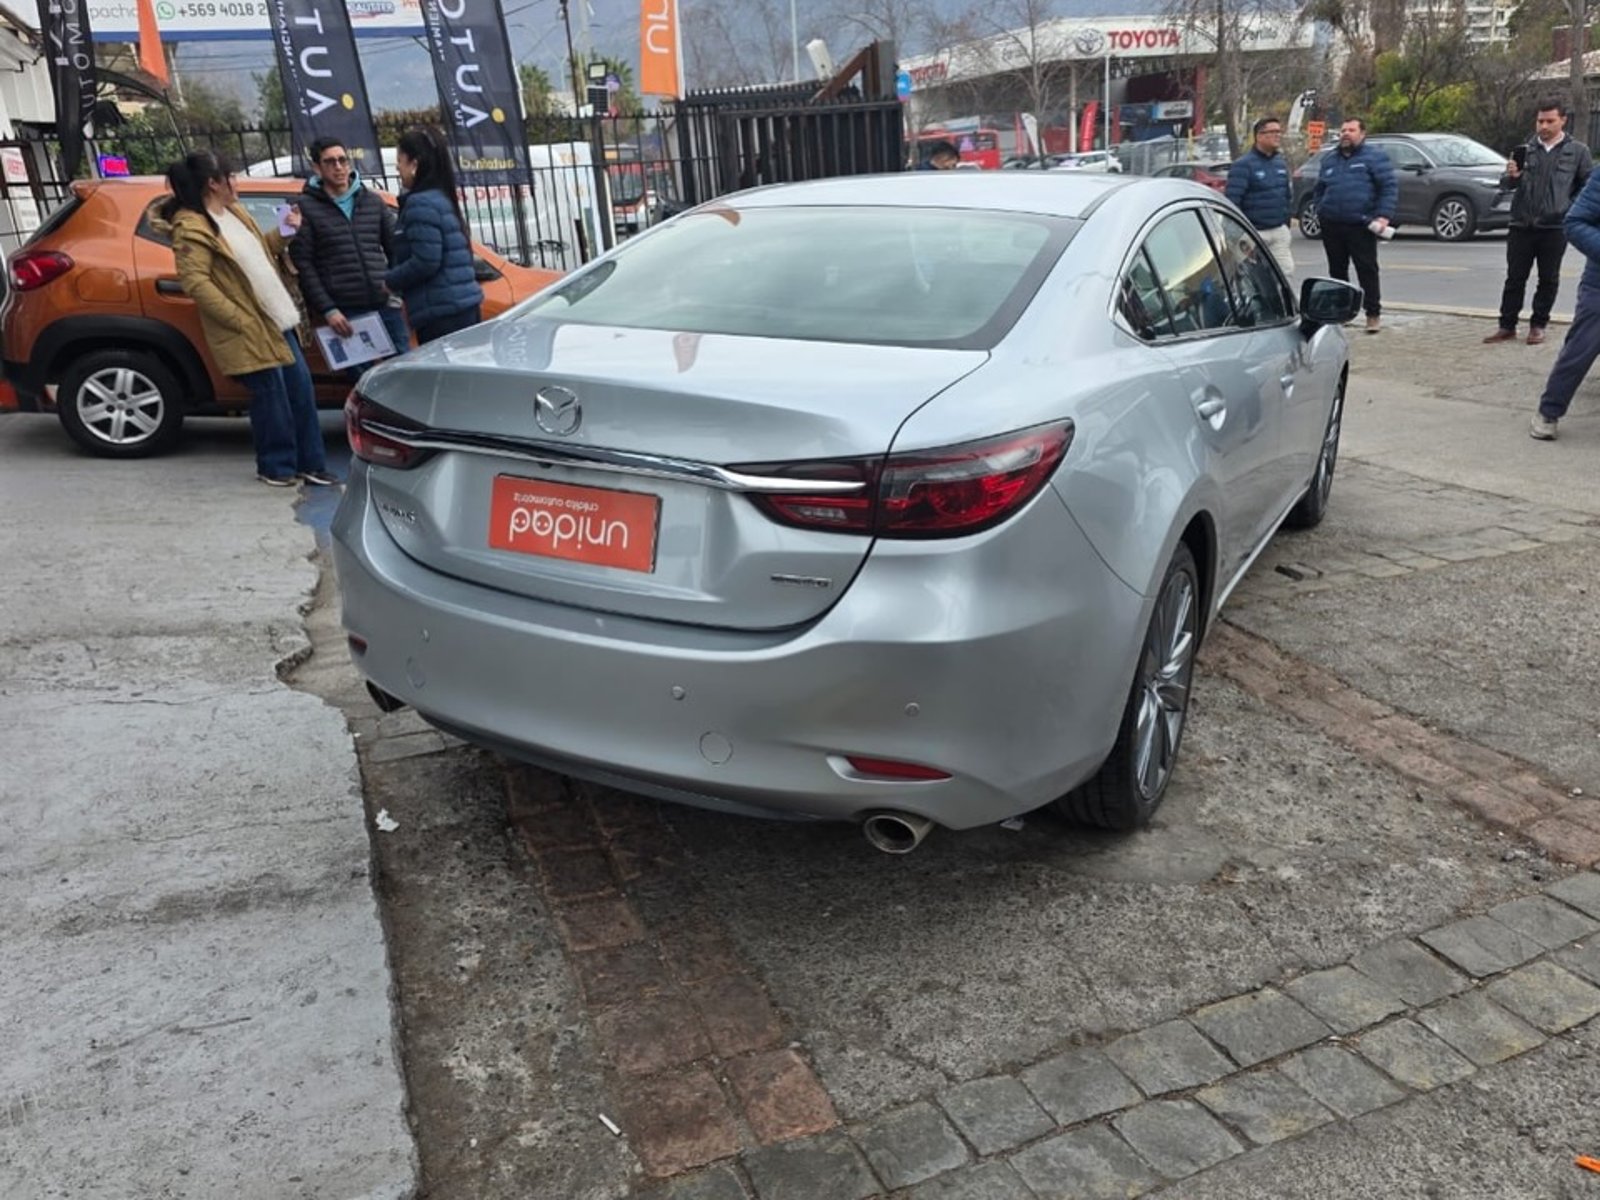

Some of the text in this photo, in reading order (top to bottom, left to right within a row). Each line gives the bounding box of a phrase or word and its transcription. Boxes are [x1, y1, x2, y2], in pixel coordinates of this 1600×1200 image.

[179, 3, 217, 17] +569
[220, 2, 254, 16] 4018
[1107, 29, 1182, 49] TOYOTA
[509, 507, 628, 550] unidad
